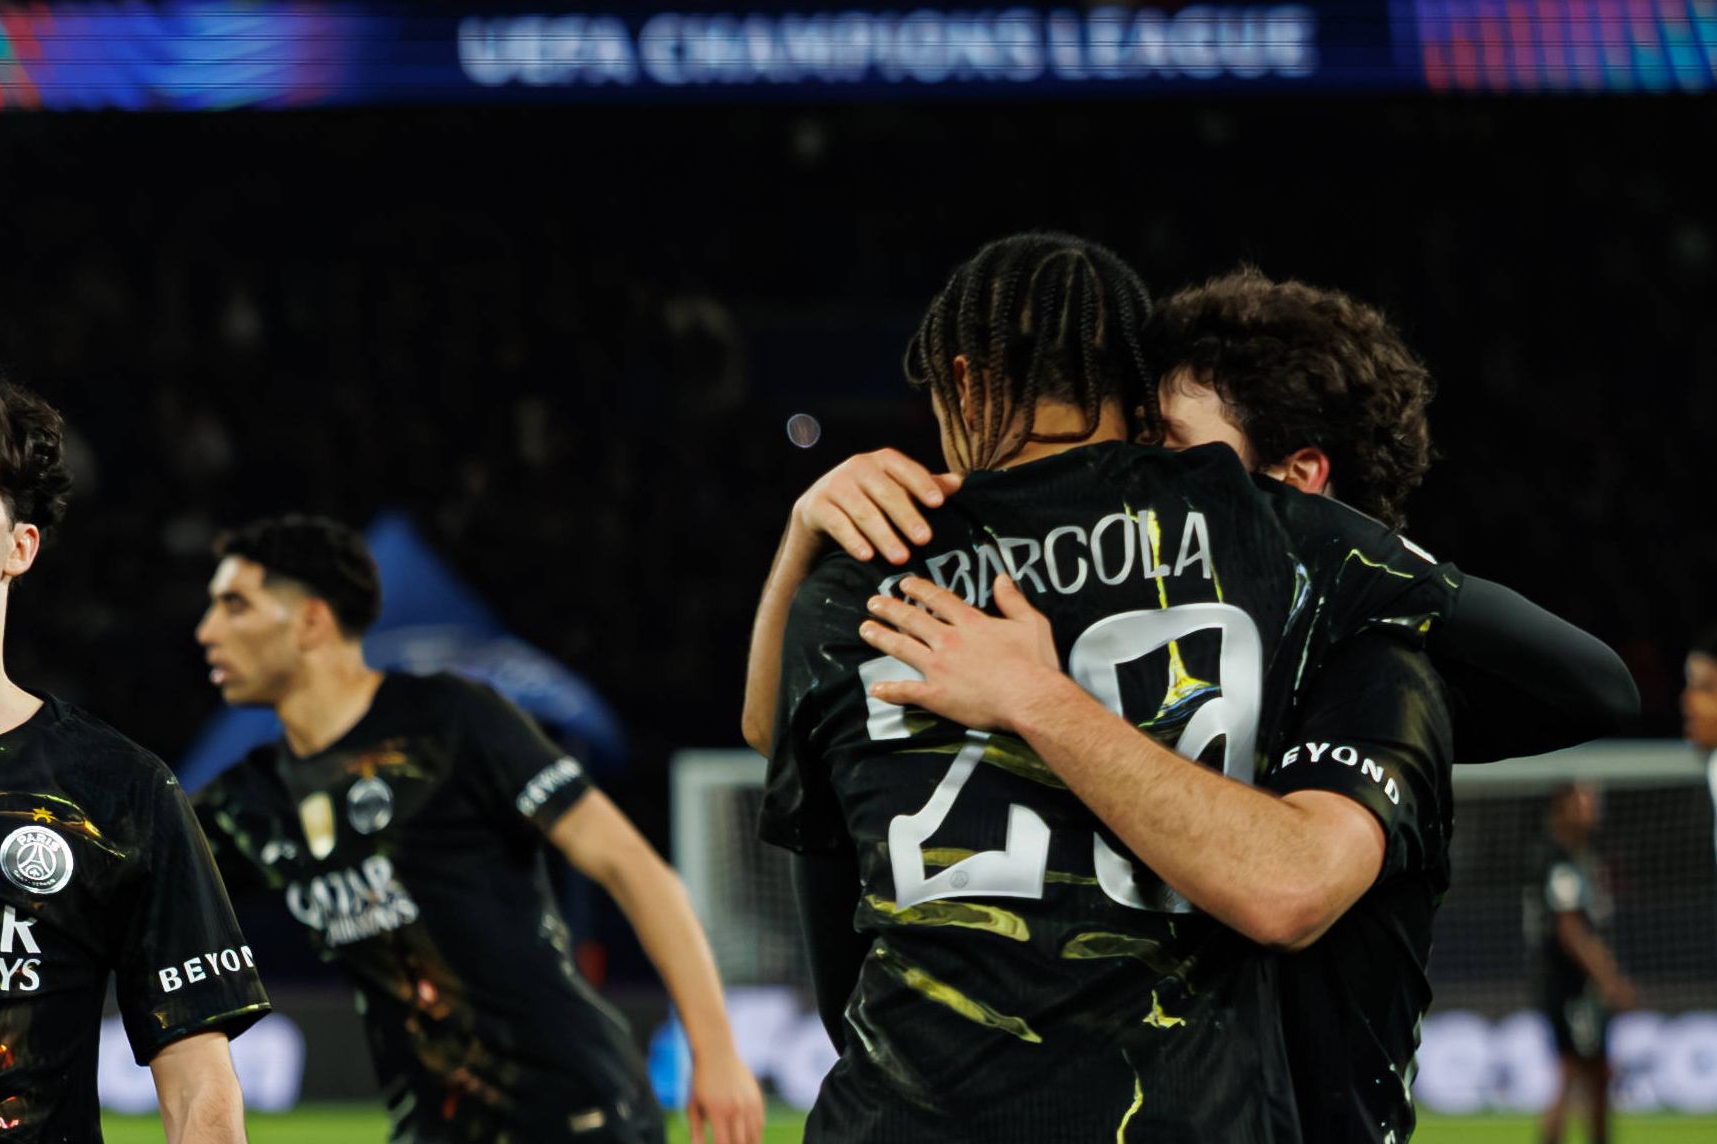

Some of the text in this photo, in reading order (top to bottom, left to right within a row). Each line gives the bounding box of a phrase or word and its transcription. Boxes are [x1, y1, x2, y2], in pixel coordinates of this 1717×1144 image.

[457, 9, 1313, 84] UEFA CHAMPIONS LEAGUE
[1271, 742, 1400, 805] EYOND
[16, 832, 61, 853] PARIS
